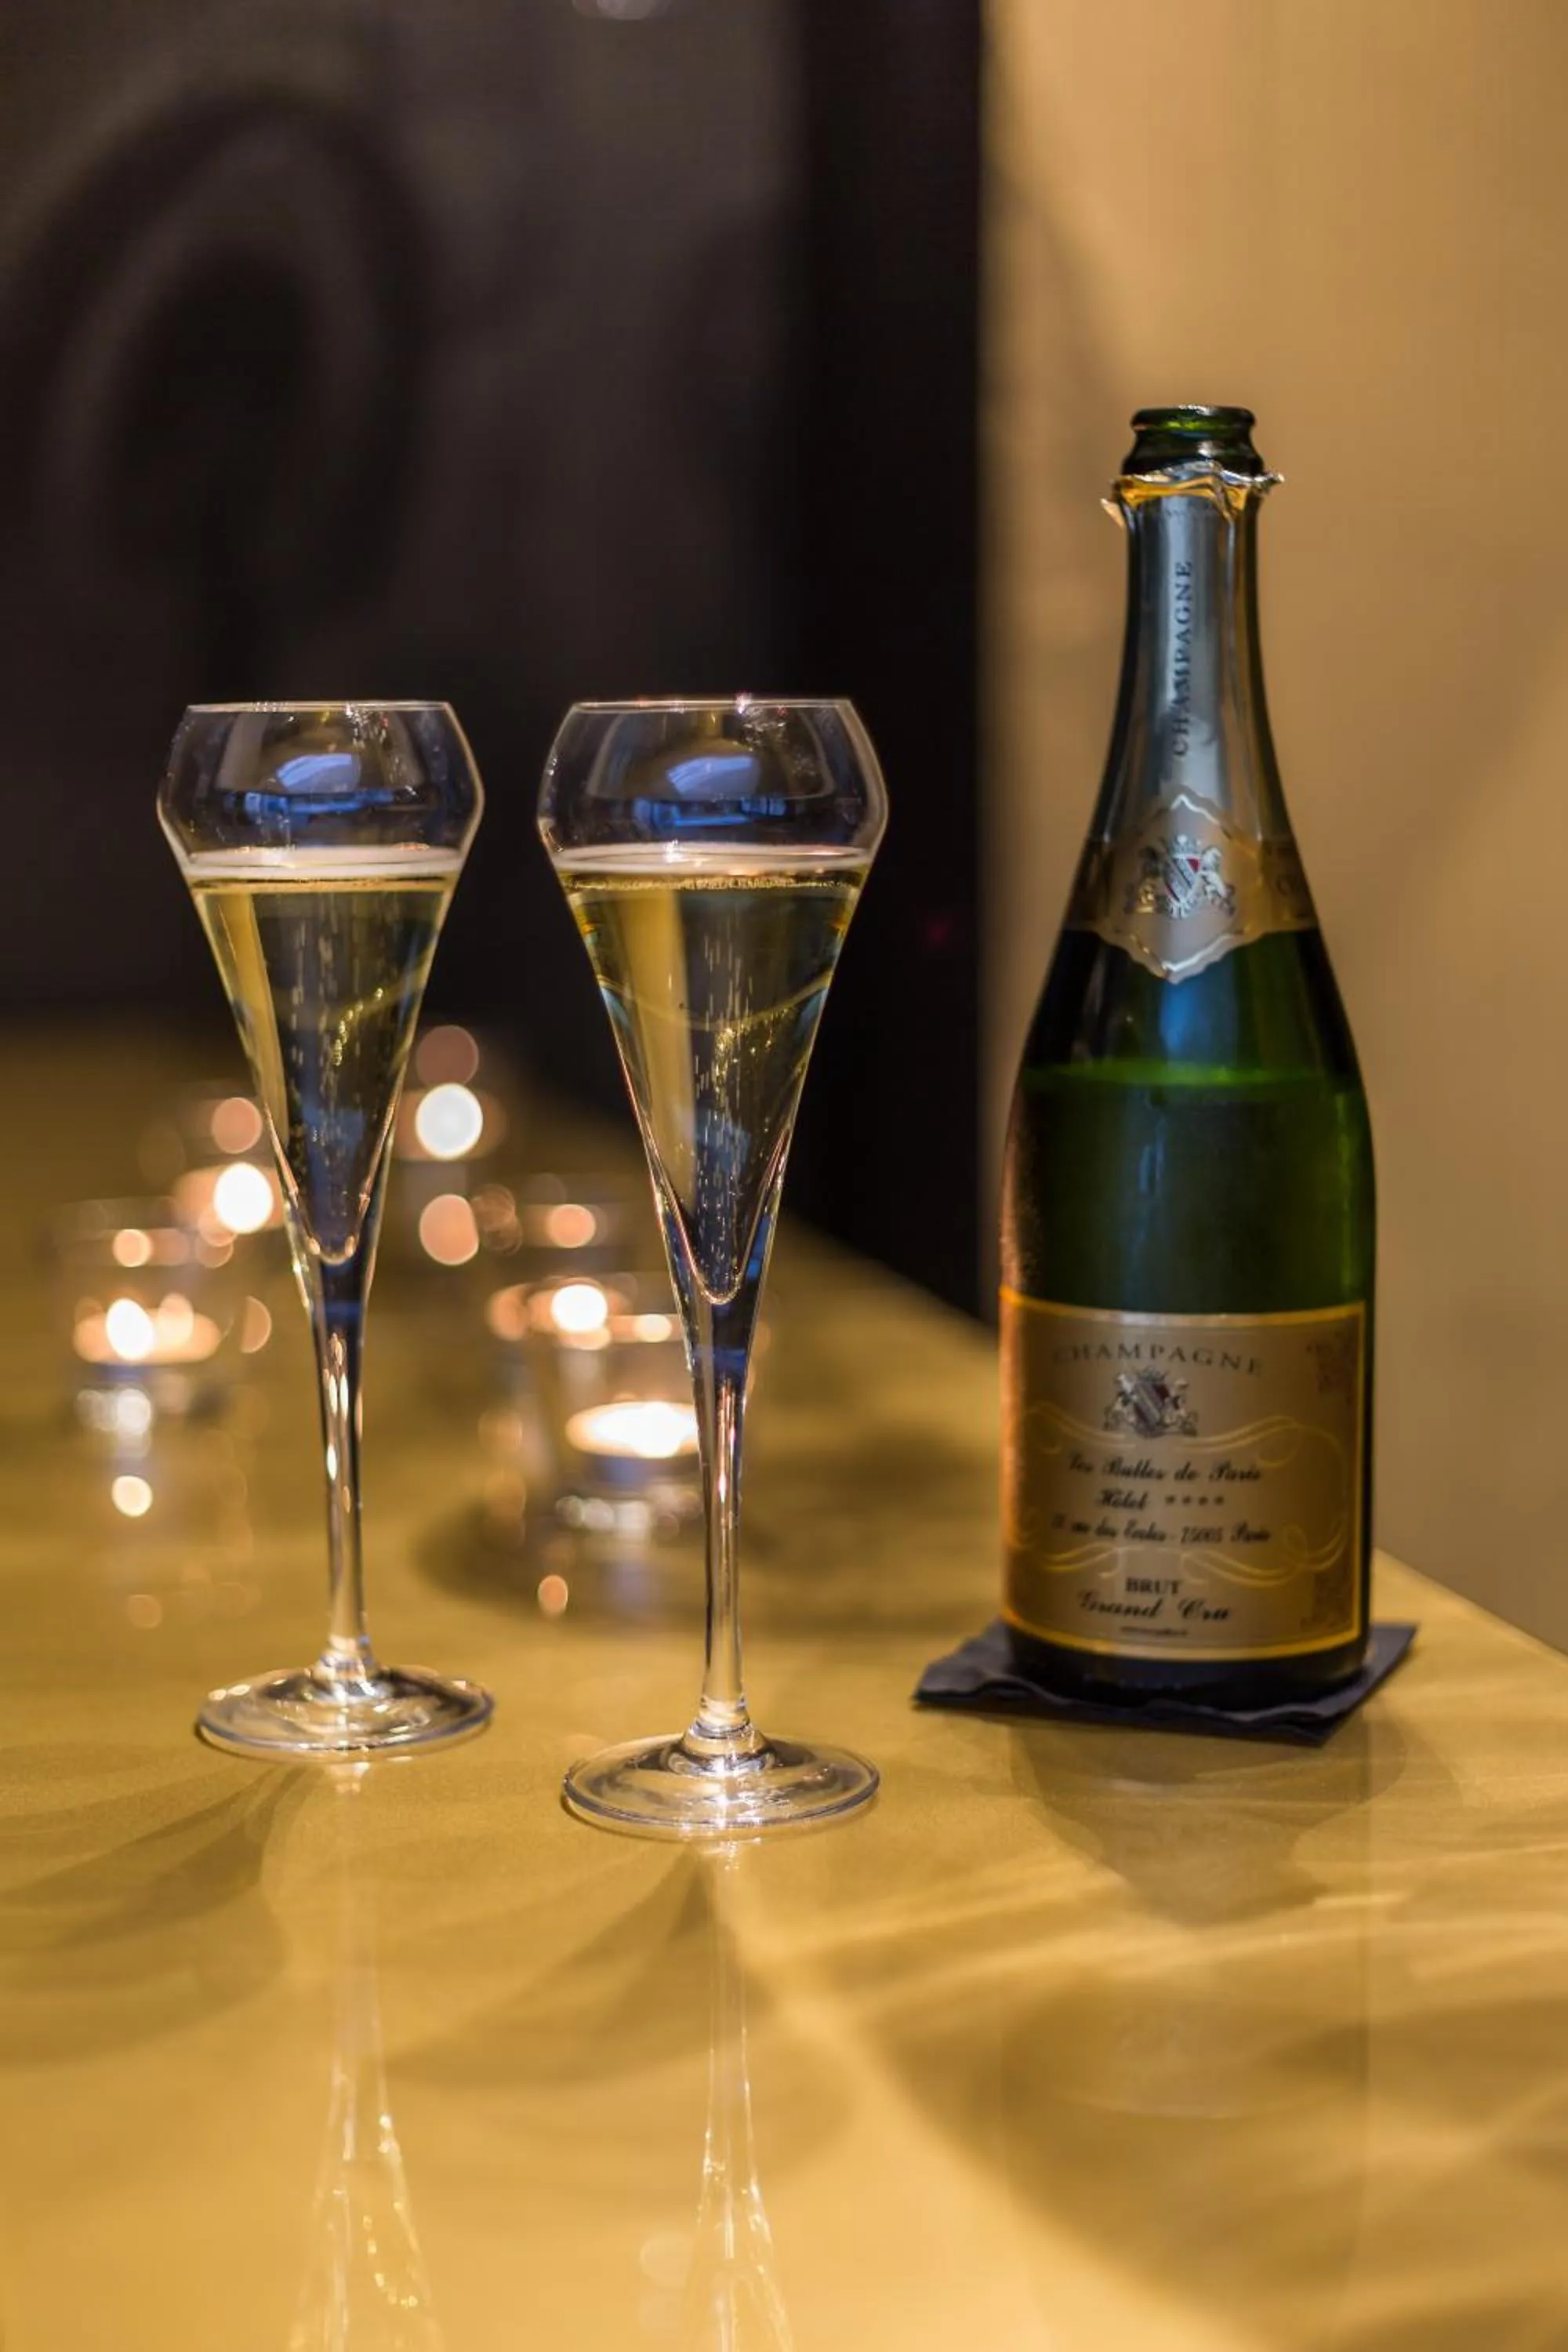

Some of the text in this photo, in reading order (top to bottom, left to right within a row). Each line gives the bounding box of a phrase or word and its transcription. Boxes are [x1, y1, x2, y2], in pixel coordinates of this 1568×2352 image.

[1171, 561, 1192, 757] CHAMPAGNE
[1053, 1341, 1263, 1376] CHAMPAGNE
[1174, 1461, 1200, 1481] de
[1126, 1577, 1181, 1595] BRUT
[1077, 1588, 1231, 1621] Grand Cru
